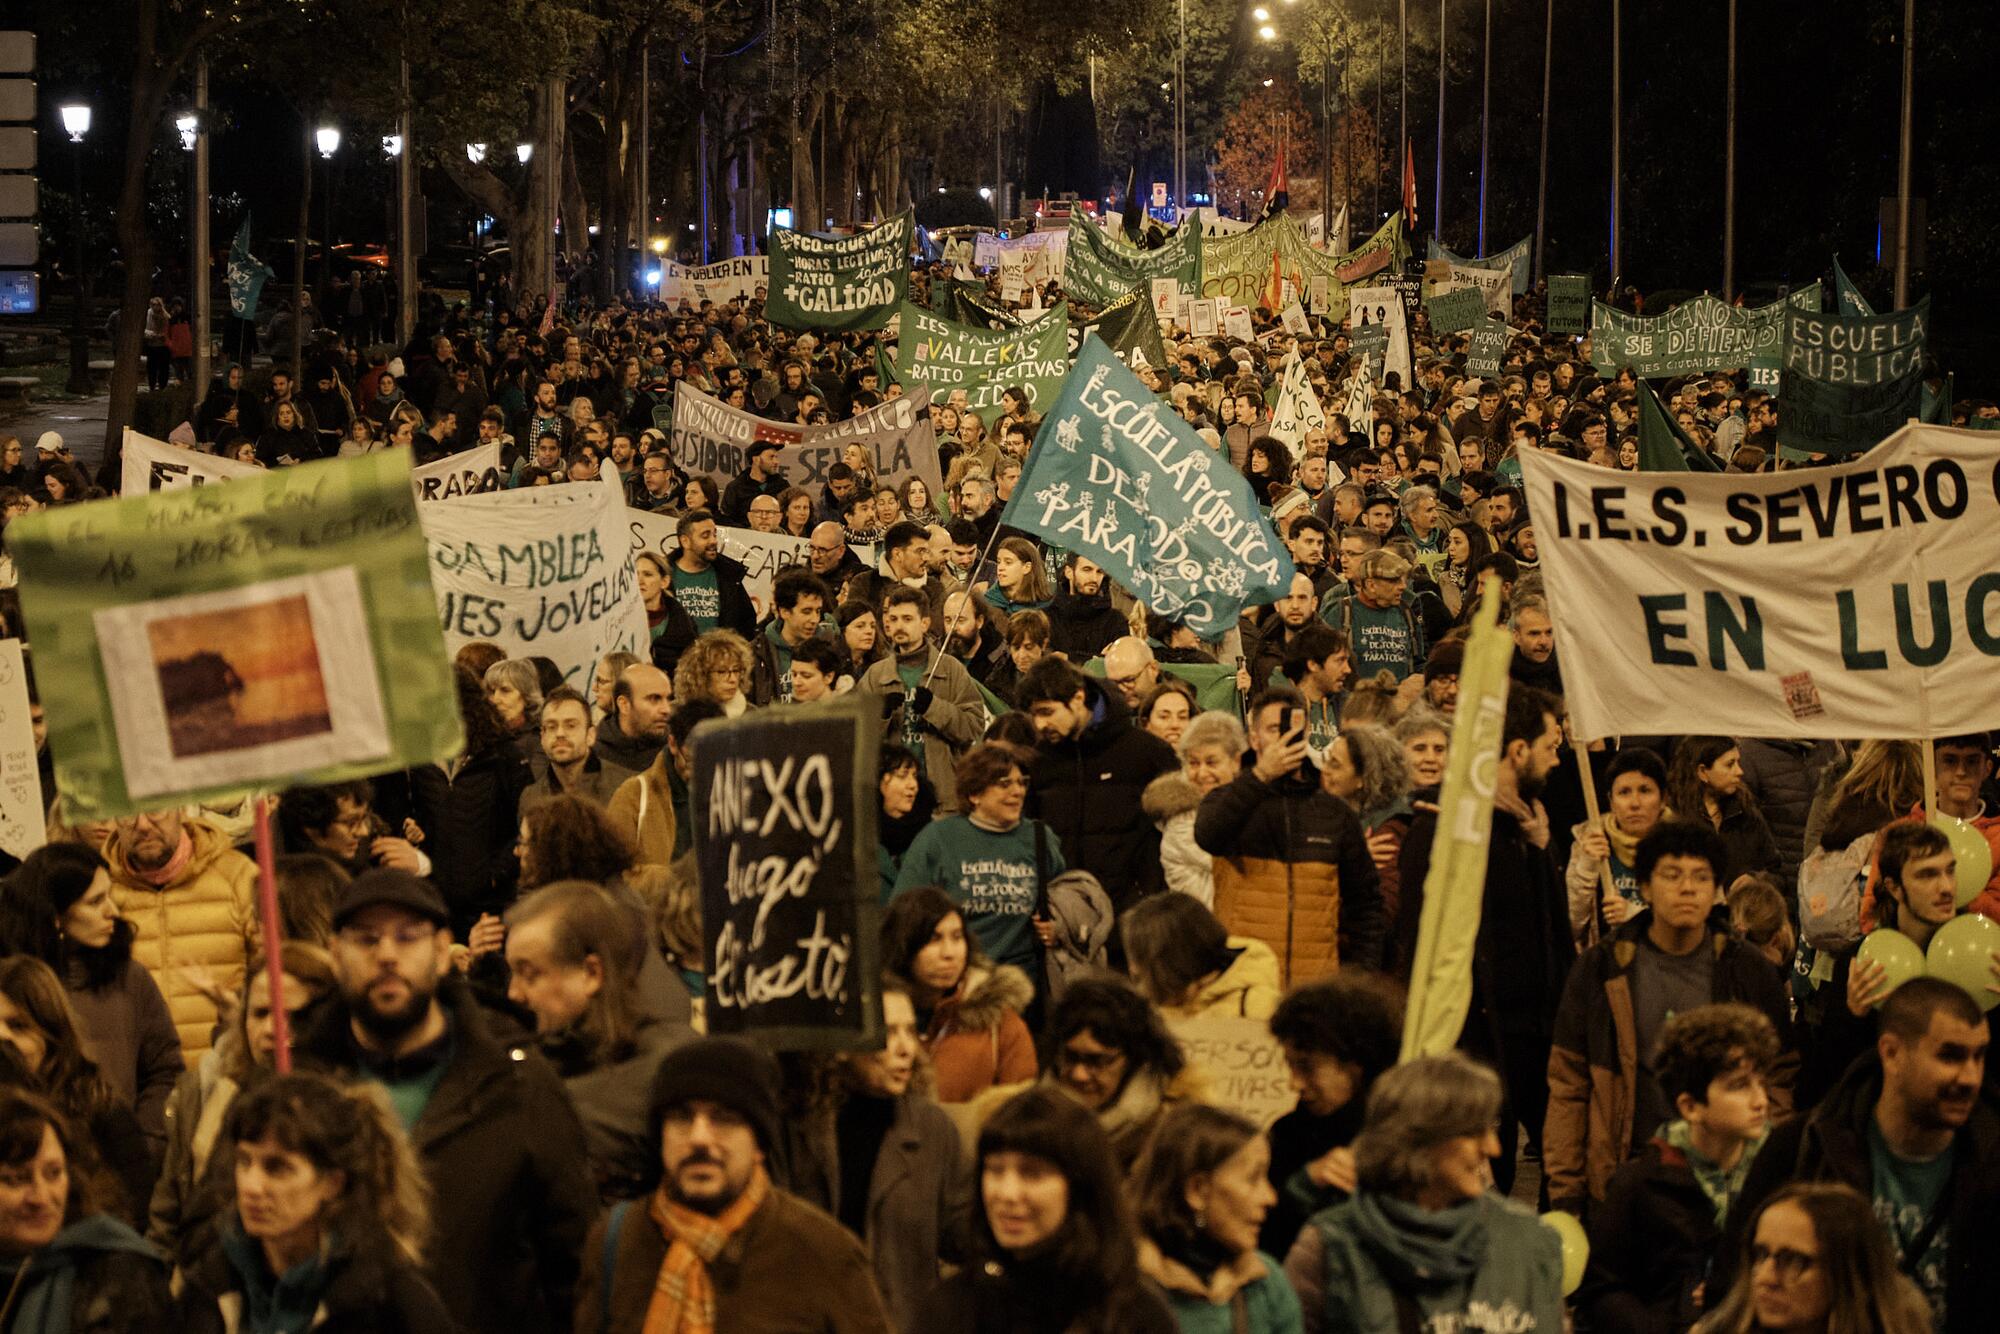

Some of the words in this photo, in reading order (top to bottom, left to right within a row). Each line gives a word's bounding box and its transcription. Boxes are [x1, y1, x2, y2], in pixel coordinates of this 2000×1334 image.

[835, 217, 905, 254] QUEVEDO
[733, 259, 752, 277] EN
[855, 253, 894, 288] igual
[915, 314, 950, 337] IES
[1592, 303, 1614, 332] LA
[1694, 299, 1731, 329] NO
[1474, 331, 1503, 346] HORAS
[1624, 335, 1653, 357] SE
[1791, 313, 1926, 353] ESCUELA
[928, 336, 1042, 367] VALLEKAS
[1464, 357, 1500, 372] ATENCIÓN
[1641, 362, 1660, 373] IES
[1706, 356, 1721, 367] DE
[1752, 367, 1780, 386] IES
[1079, 374, 1193, 491] ESCUELA
[1554, 480, 1706, 548] I.E.S.
[1724, 458, 1969, 547] SEVERO
[1039, 496, 1138, 568] PARA
[443, 592, 505, 638] IES
[1639, 591, 1767, 672] EN
